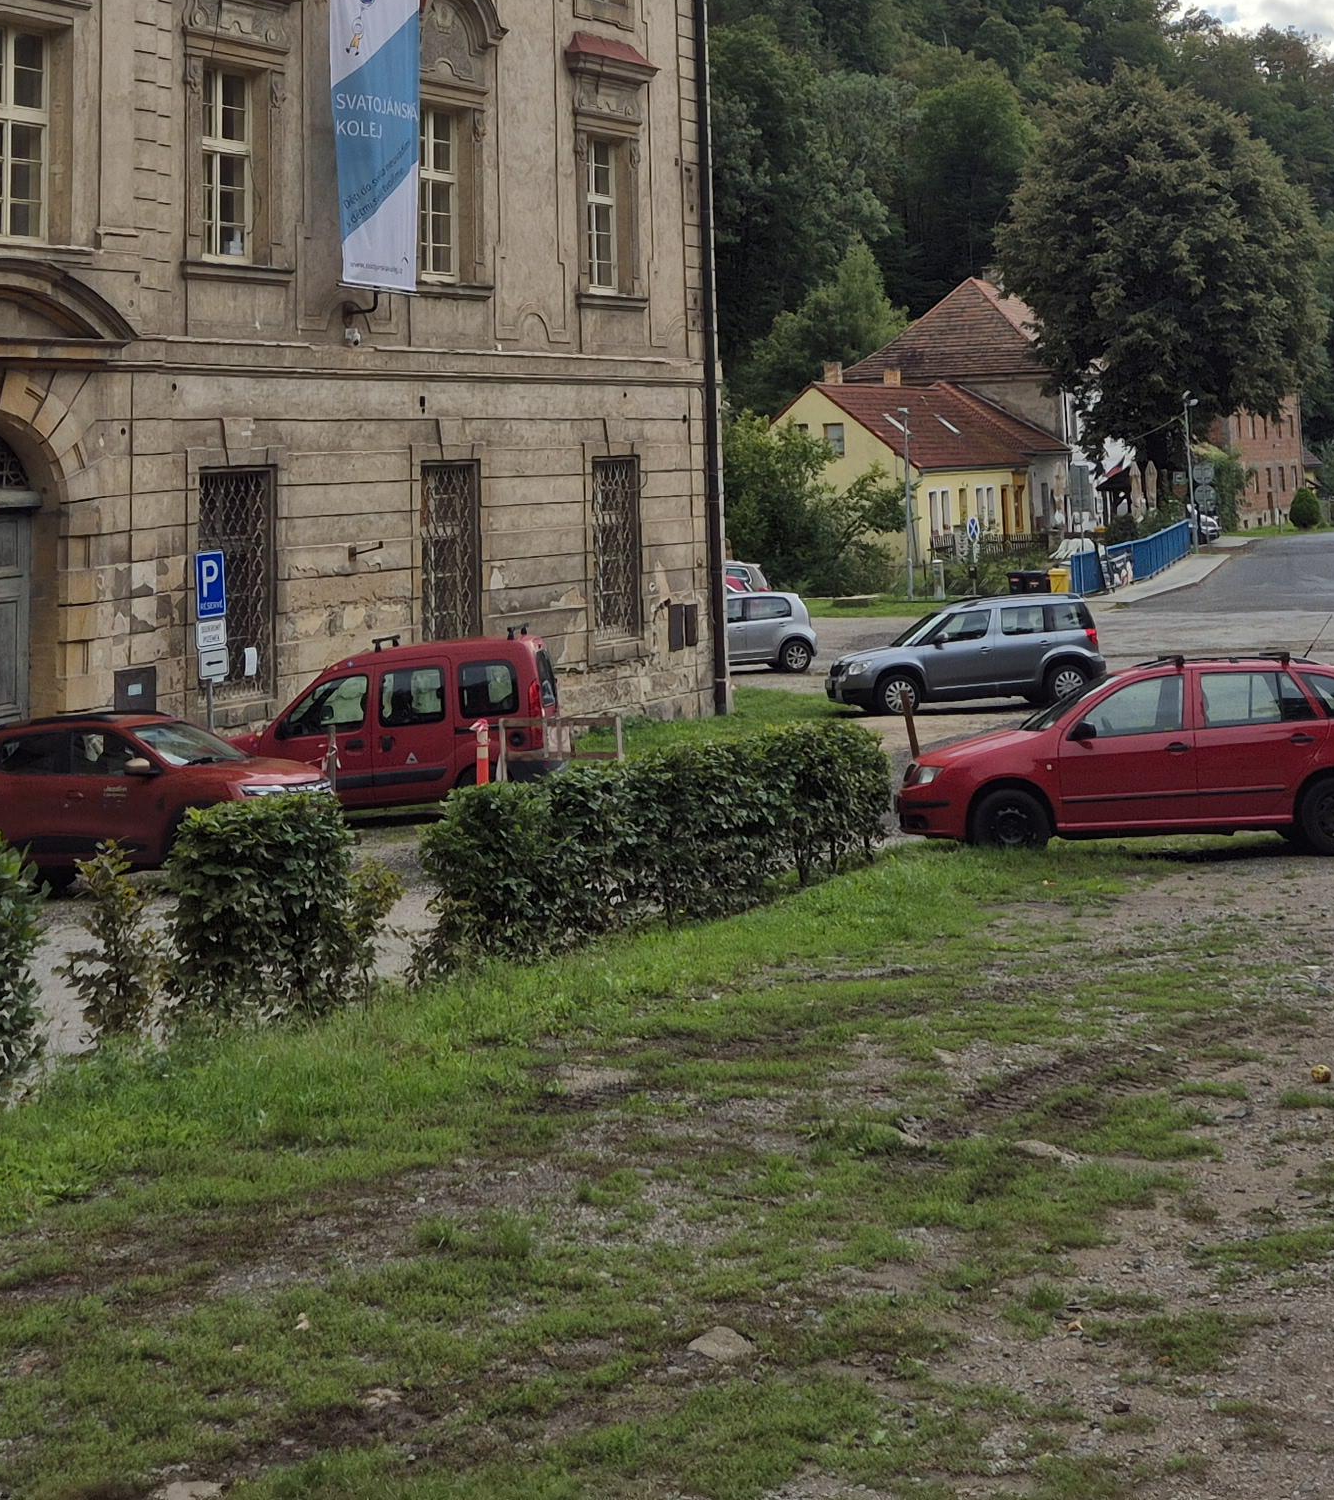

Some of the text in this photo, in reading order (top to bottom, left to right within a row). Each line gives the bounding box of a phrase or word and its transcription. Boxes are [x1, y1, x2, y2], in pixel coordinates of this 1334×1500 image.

[336, 92, 419, 122] SVATOJÁNSKÁ
[336, 119, 383, 139] KOLEJ
[202, 559, 219, 598] P
